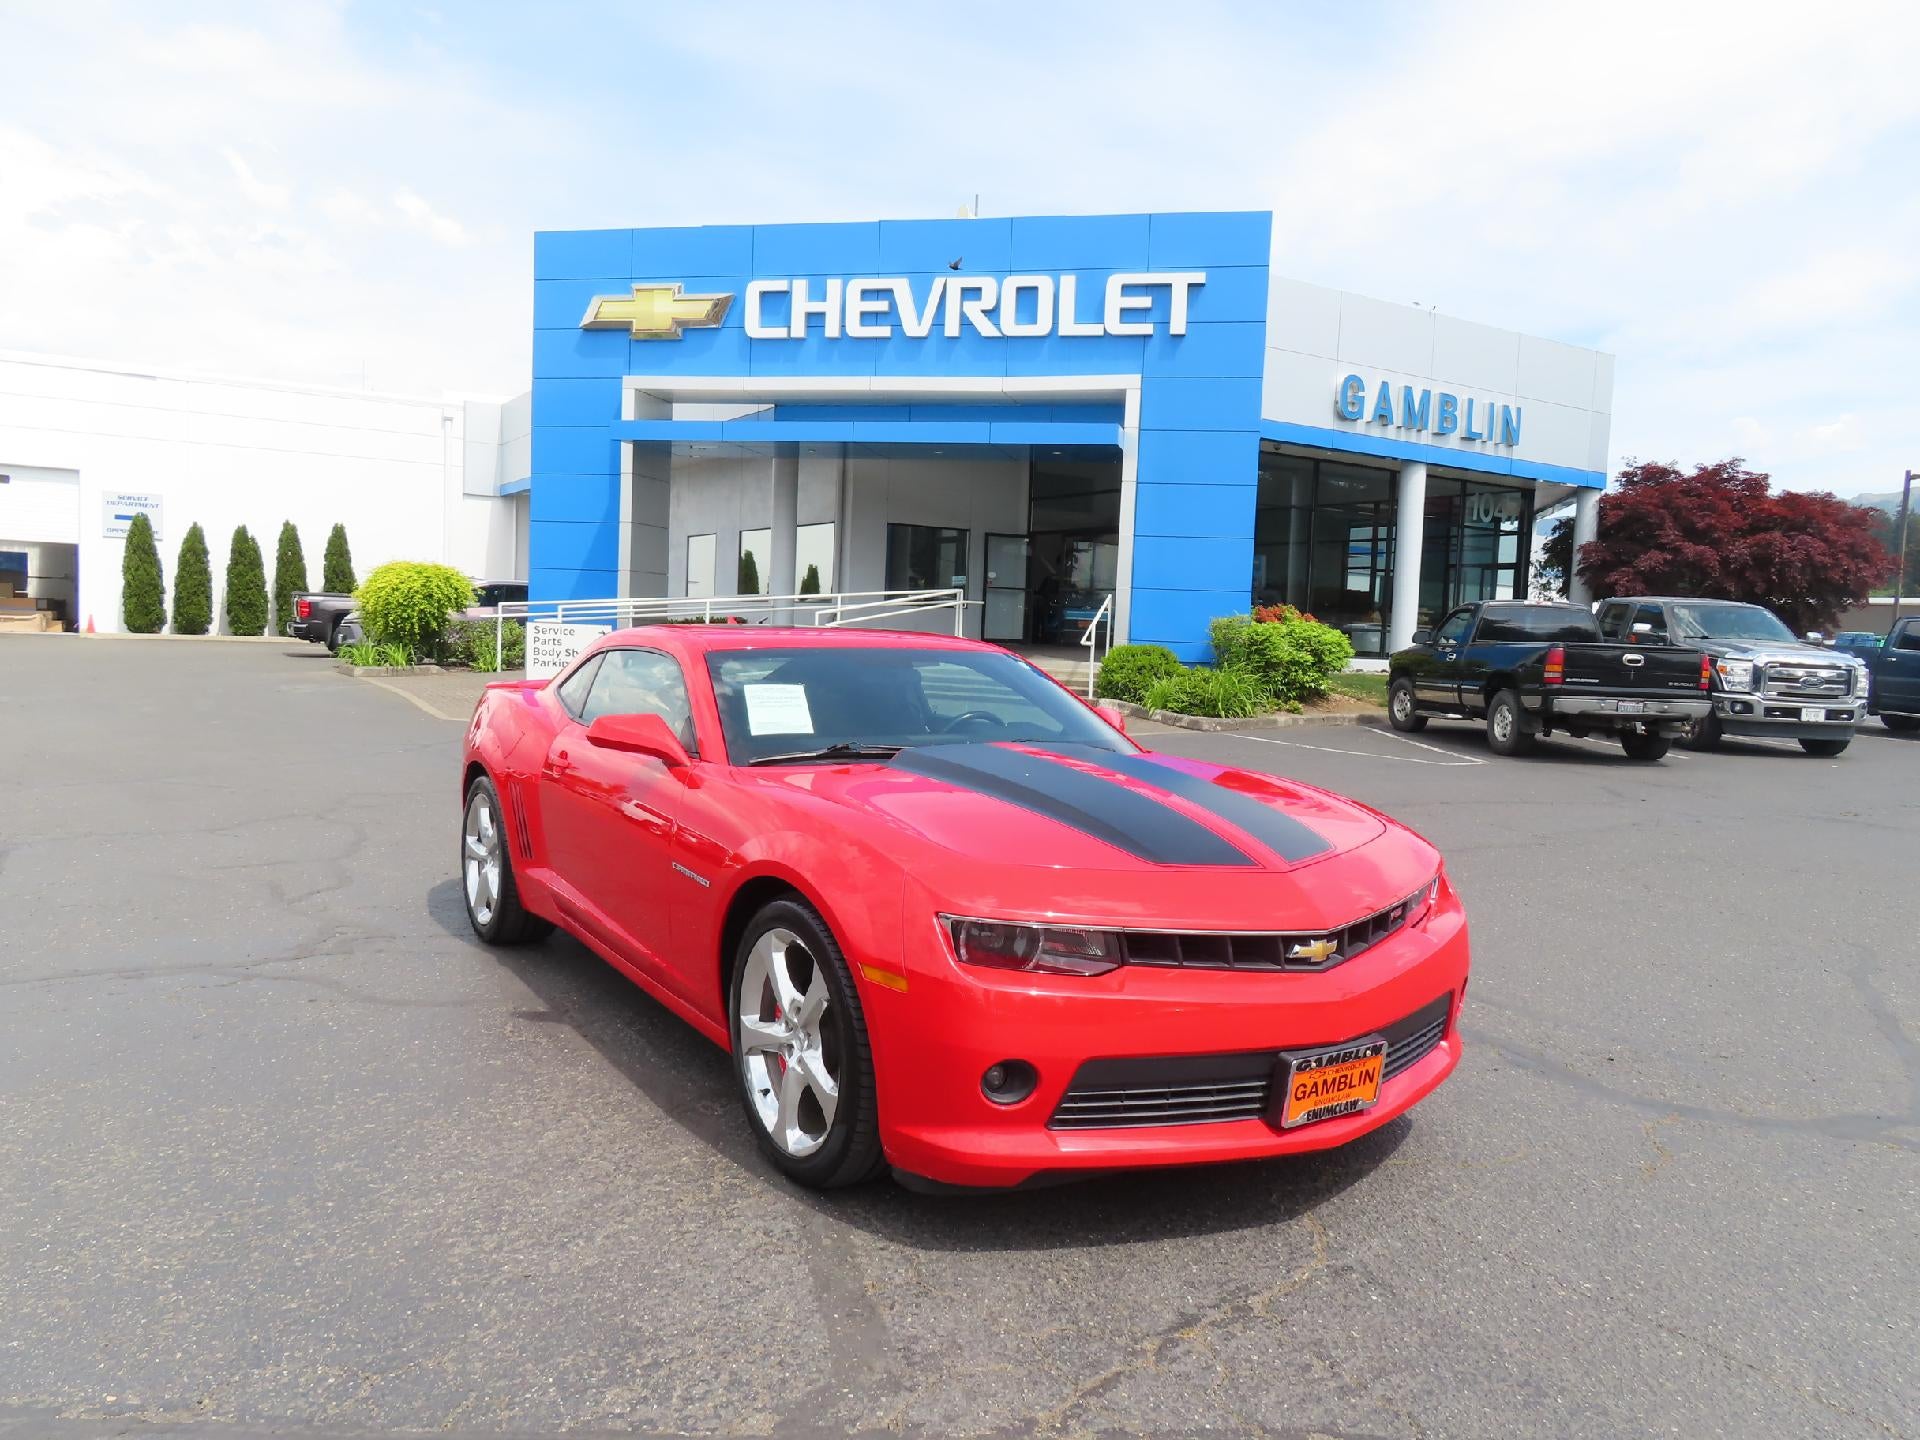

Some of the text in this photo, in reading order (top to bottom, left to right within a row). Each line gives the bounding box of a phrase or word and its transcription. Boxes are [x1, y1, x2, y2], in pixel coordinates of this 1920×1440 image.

[744, 272, 1206, 339] CHEVROLET
[1336, 374, 1521, 446] GAMBLIN
[106, 500, 160, 509] DEPARTMENT
[533, 625, 576, 636] Service
[533, 636, 562, 646] Parts
[533, 646, 580, 658] Body Sh
[533, 657, 570, 668] Parkin
[1294, 1067, 1376, 1101] GAMBLIN
[1306, 1098, 1361, 1121] ENUMCLAW
